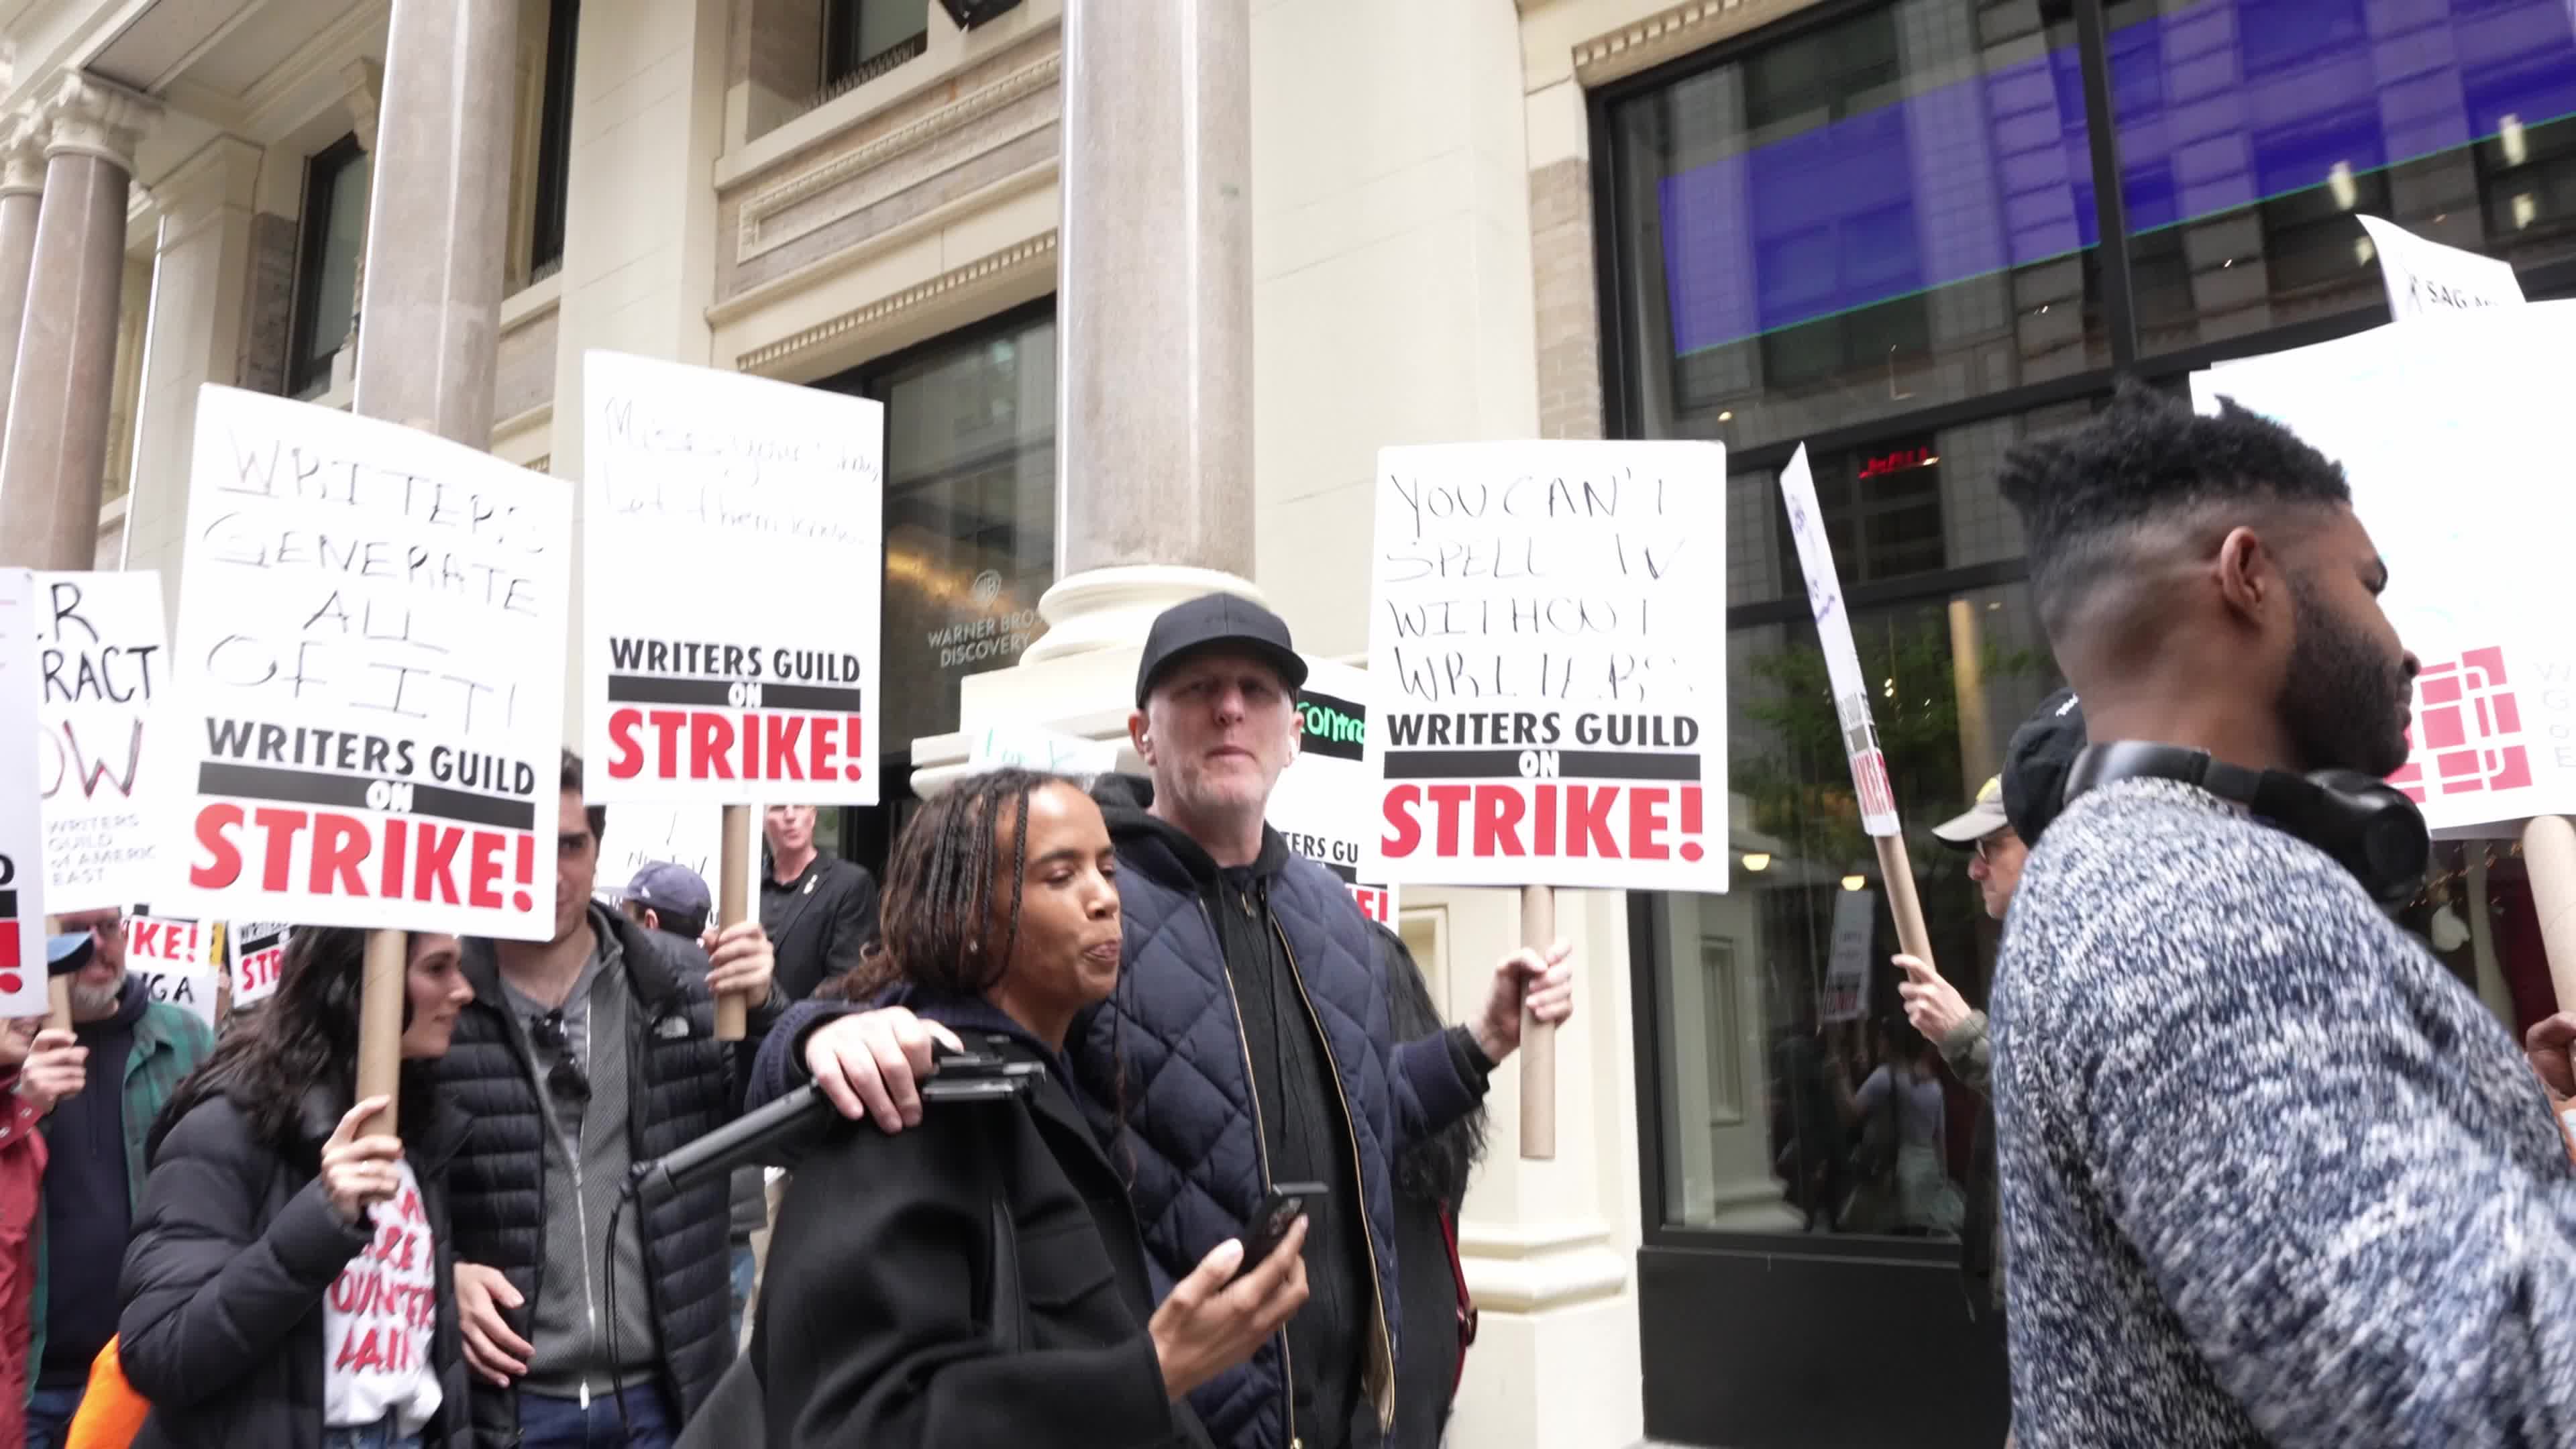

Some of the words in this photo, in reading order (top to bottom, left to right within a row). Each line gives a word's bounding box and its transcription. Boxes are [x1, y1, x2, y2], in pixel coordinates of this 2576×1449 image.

[1391, 474, 1487, 539] YOU
[203, 511, 538, 617] GENERATE
[1384, 537, 1544, 583] SPELL
[302, 589, 450, 655] ALL
[928, 616, 996, 649] WARNER
[940, 631, 1031, 668] DISCOVERY
[205, 633, 328, 700] OF
[610, 636, 763, 678] WRITERS
[773, 648, 861, 683] GUILD
[728, 682, 763, 708] ON
[206, 716, 415, 777] WRITERS
[429, 745, 535, 796] GUILD
[608, 708, 863, 782] STRIKE!
[1387, 711, 1562, 746] WRITERS
[1574, 714, 1700, 747] GUILD
[1517, 749, 1560, 778] ON
[366, 780, 414, 812] ON
[1379, 783, 1705, 863] STRIKE!
[189, 802, 535, 913] STRIKE!
